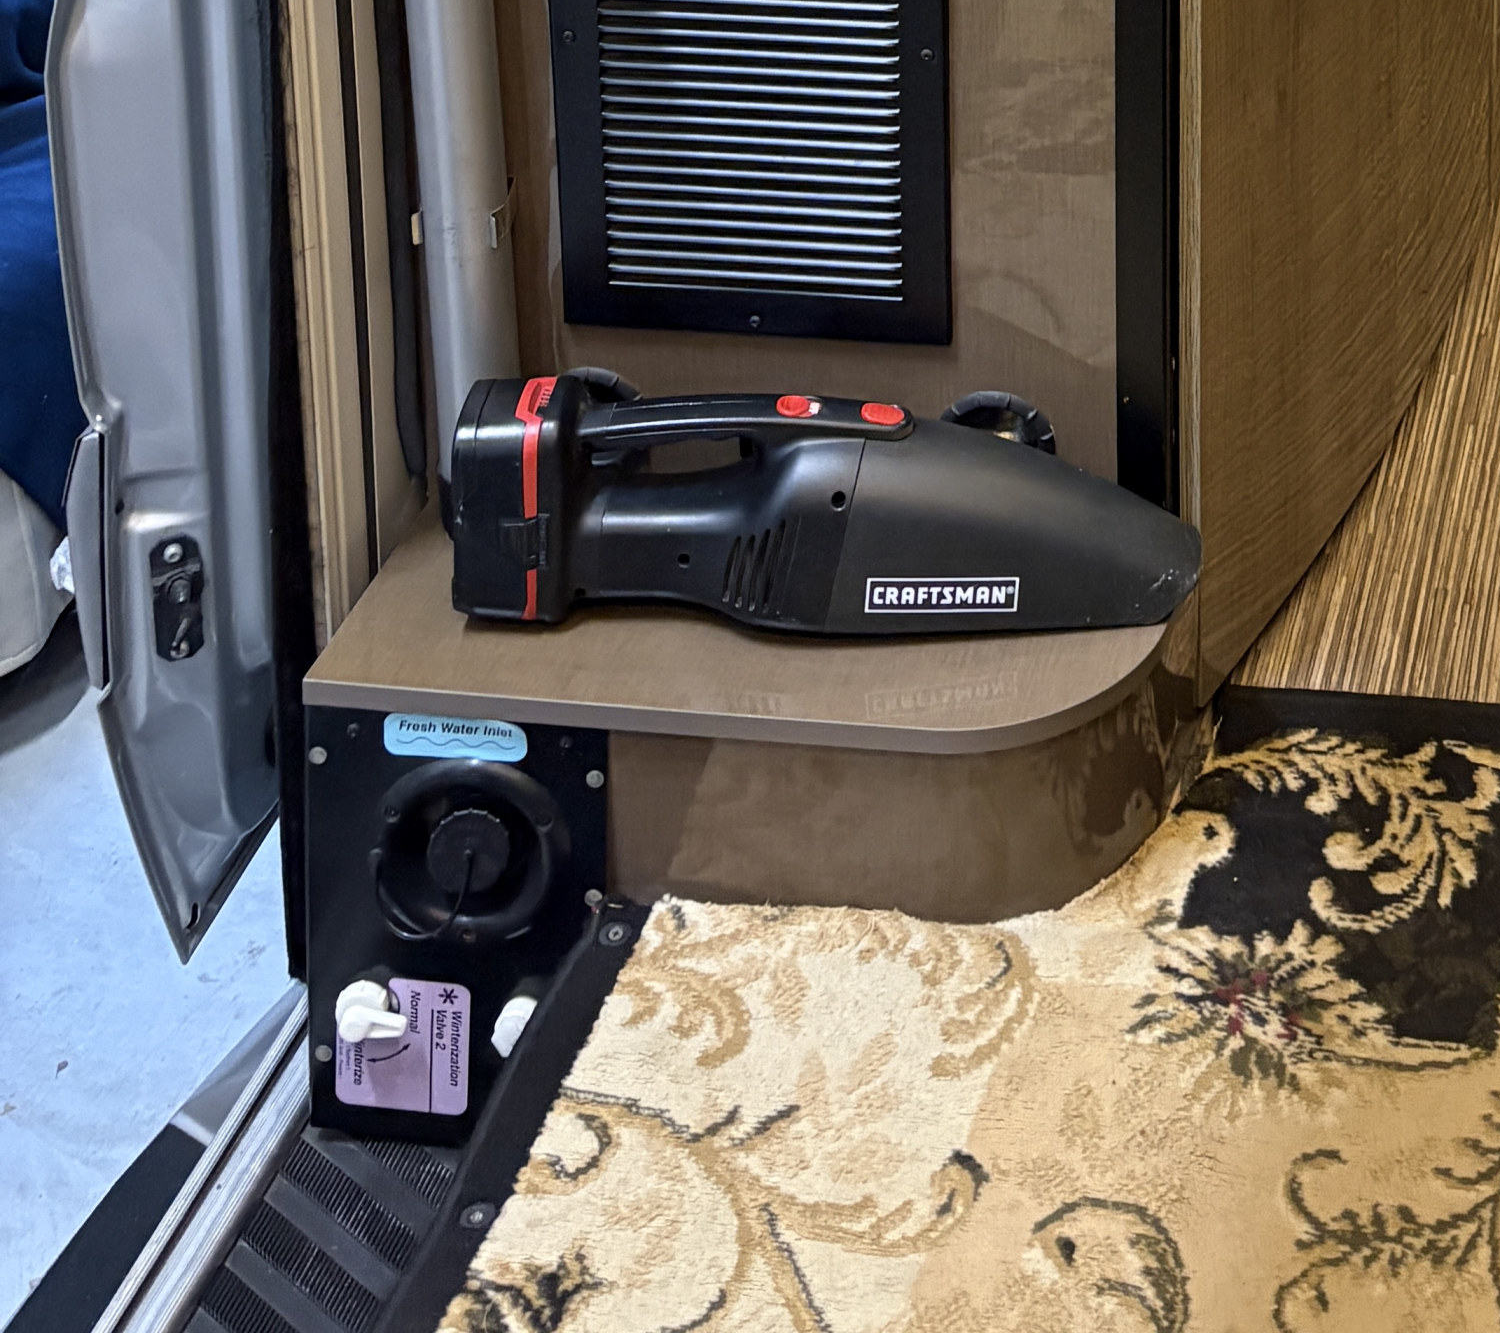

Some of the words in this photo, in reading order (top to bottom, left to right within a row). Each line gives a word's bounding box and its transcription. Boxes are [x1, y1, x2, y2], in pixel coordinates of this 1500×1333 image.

[398, 720, 437, 734] Fresh
[441, 722, 480, 735] Water
[483, 725, 513, 738] Inlet
[409, 989, 422, 1035] Normal
[435, 1009, 448, 1040] Valve
[435, 1043, 446, 1051] 2
[450, 1011, 463, 1087] Winterization
